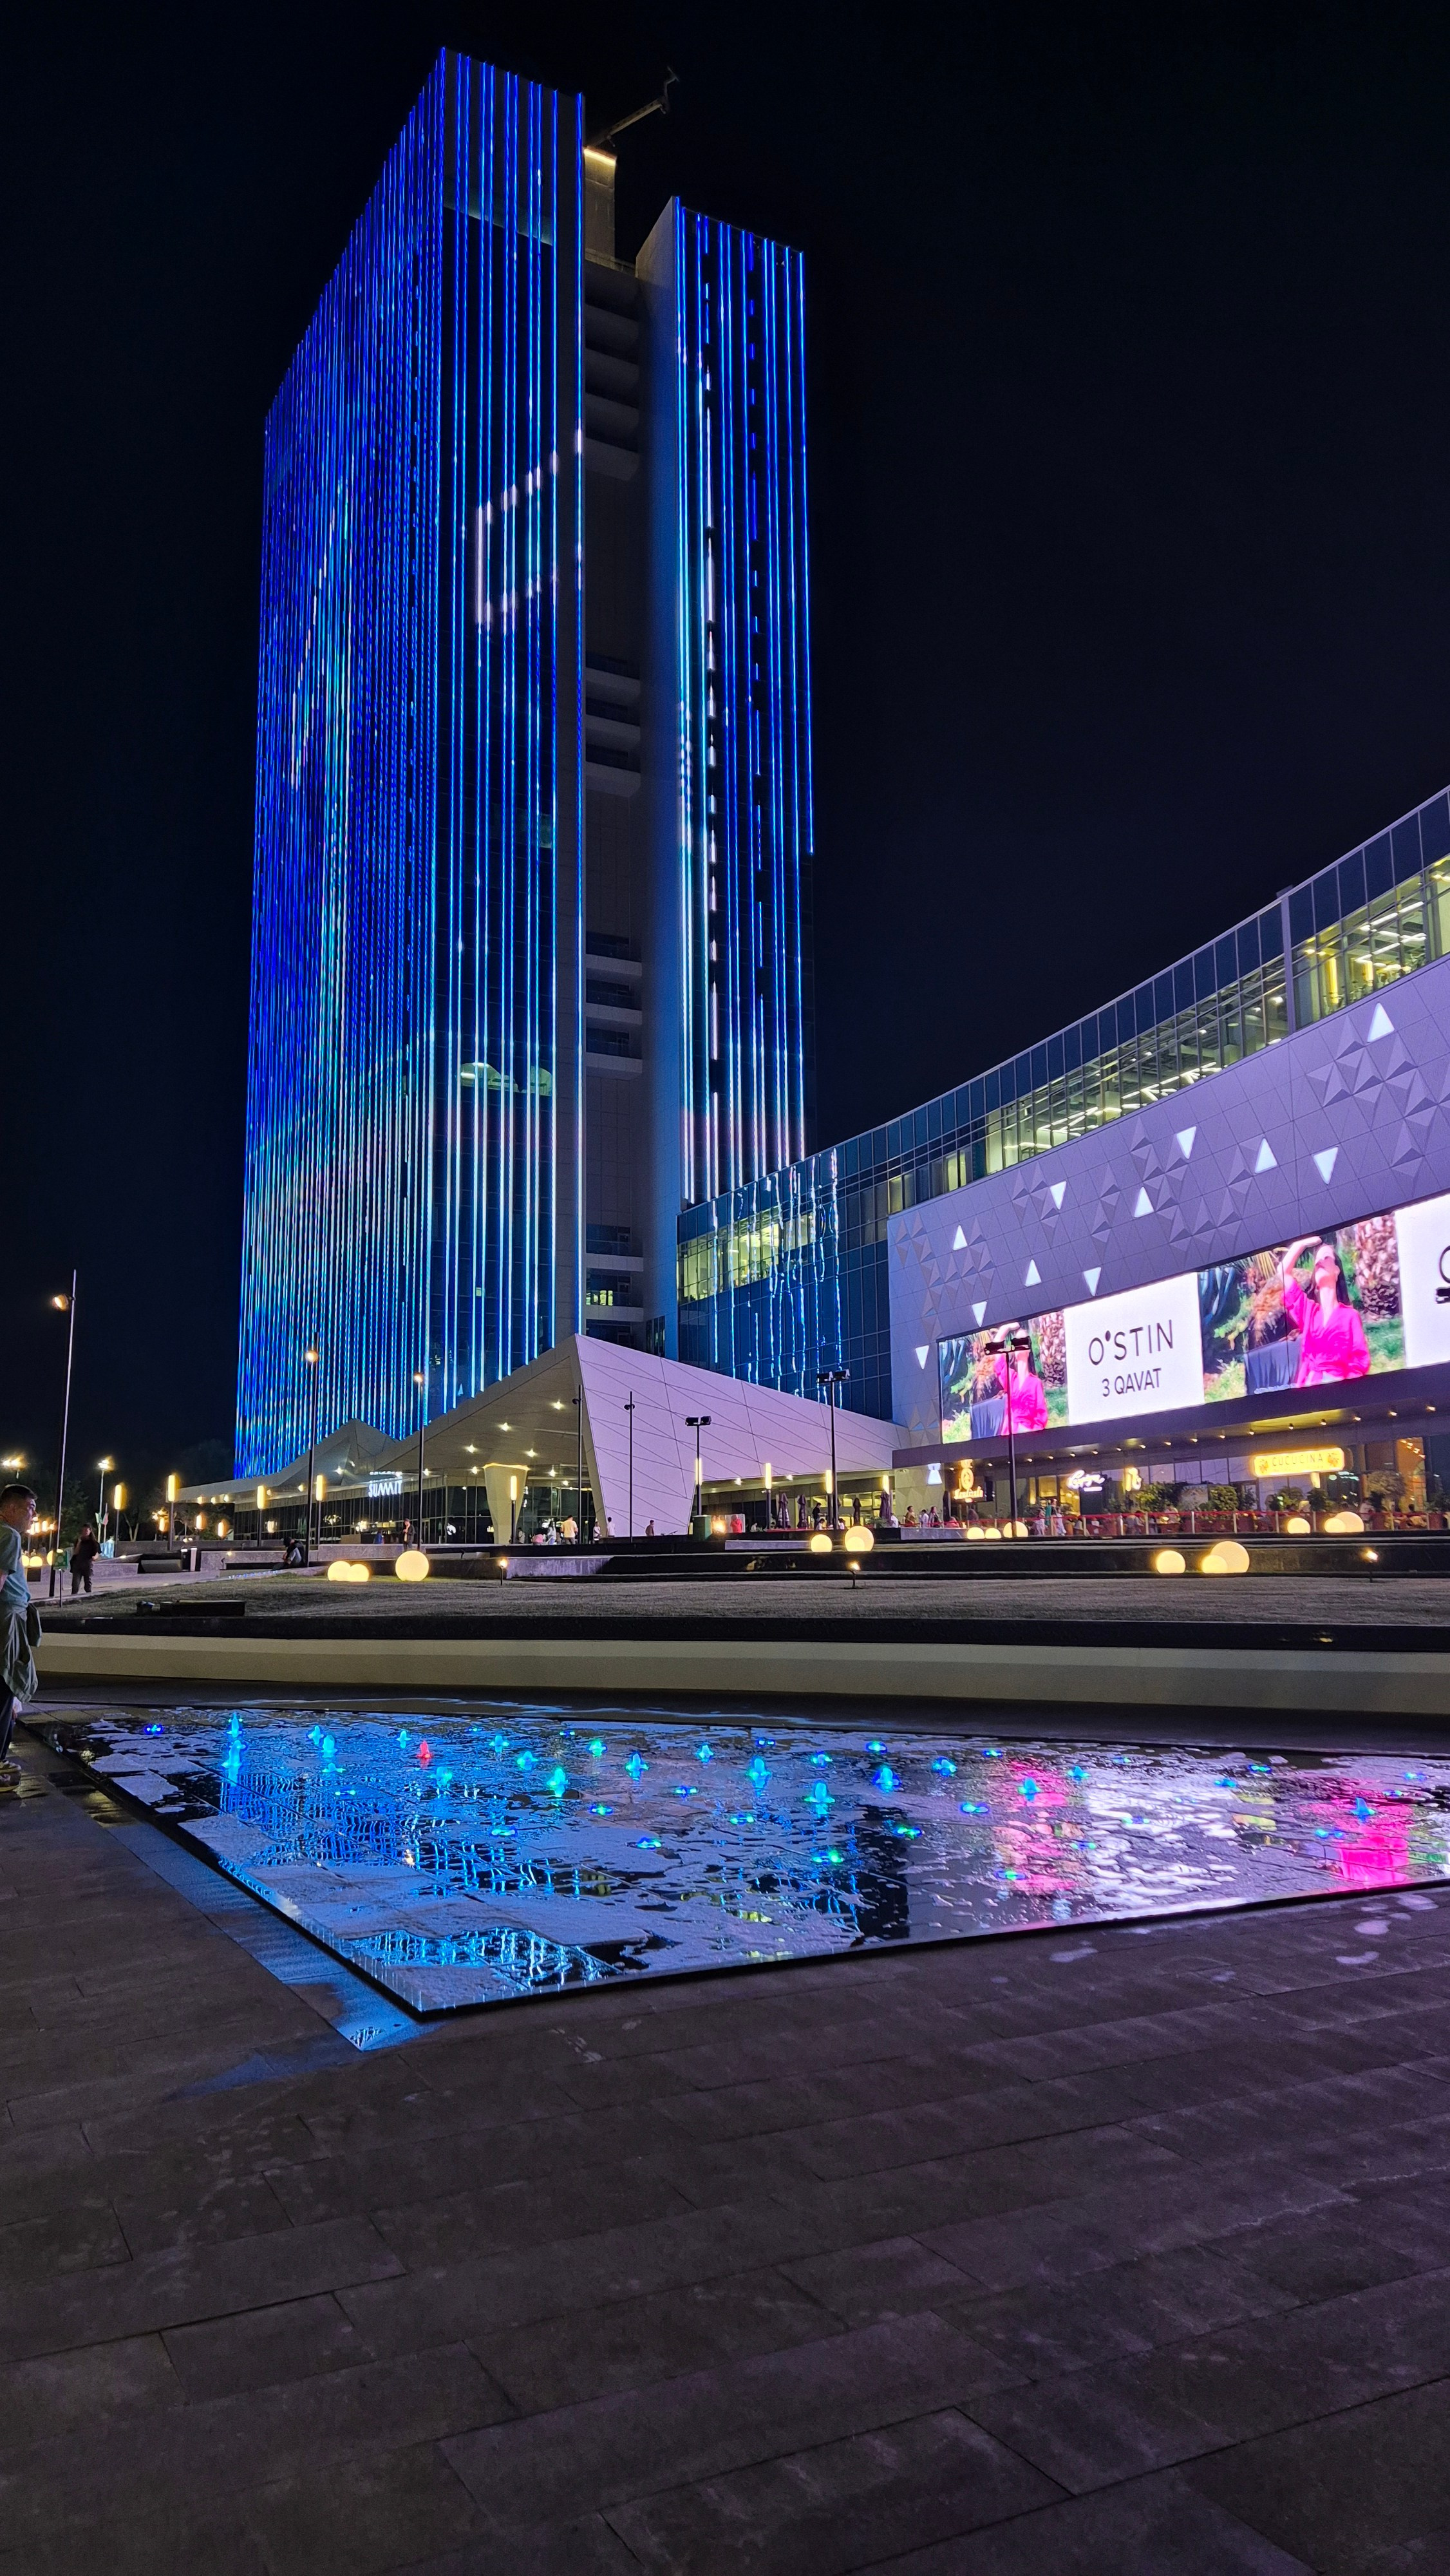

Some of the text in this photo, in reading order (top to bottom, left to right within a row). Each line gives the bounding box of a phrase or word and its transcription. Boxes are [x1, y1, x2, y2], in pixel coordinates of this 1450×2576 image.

[1102, 1368, 1162, 1397] 3 QAVAT
[1272, 1453, 1323, 1466] CUCUCINA
[368, 1480, 402, 1497] SUMMIT
